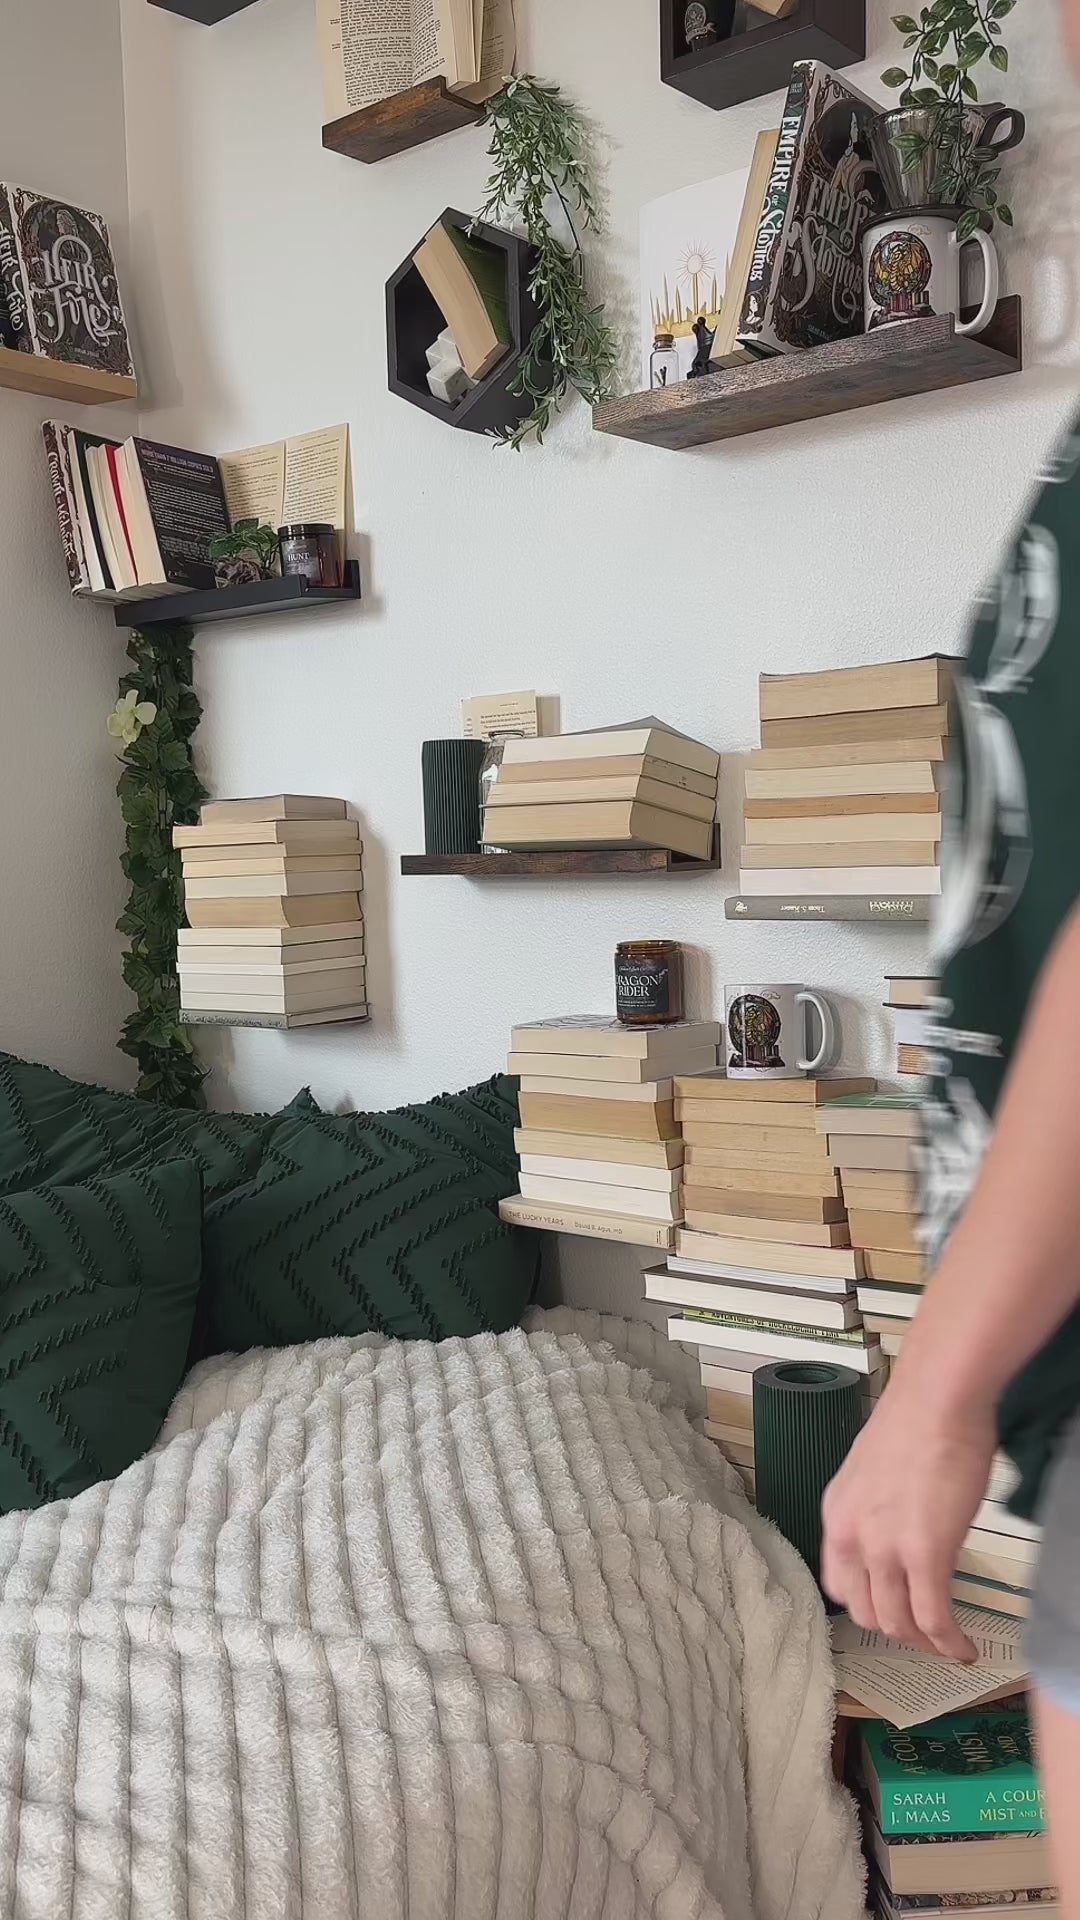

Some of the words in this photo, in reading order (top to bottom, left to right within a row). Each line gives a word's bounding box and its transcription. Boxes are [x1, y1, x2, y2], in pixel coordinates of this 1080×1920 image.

[767, 116, 802, 194] EMPIRE
[288, 552, 310, 562] HUNT
[618, 985, 651, 997] RIDER
[883, 1719, 918, 1761] COUR
[926, 1740, 946, 1752] OF
[952, 1730, 993, 1763] MIST
[893, 1792, 946, 1806] SARAH
[985, 1791, 997, 1804] A
[1002, 1789, 1047, 1803] COUR
[891, 1813, 900, 1826] J.
[905, 1809, 951, 1823] MAAS
[979, 1808, 1016, 1821] MIST
[1018, 1810, 1037, 1818] AND
